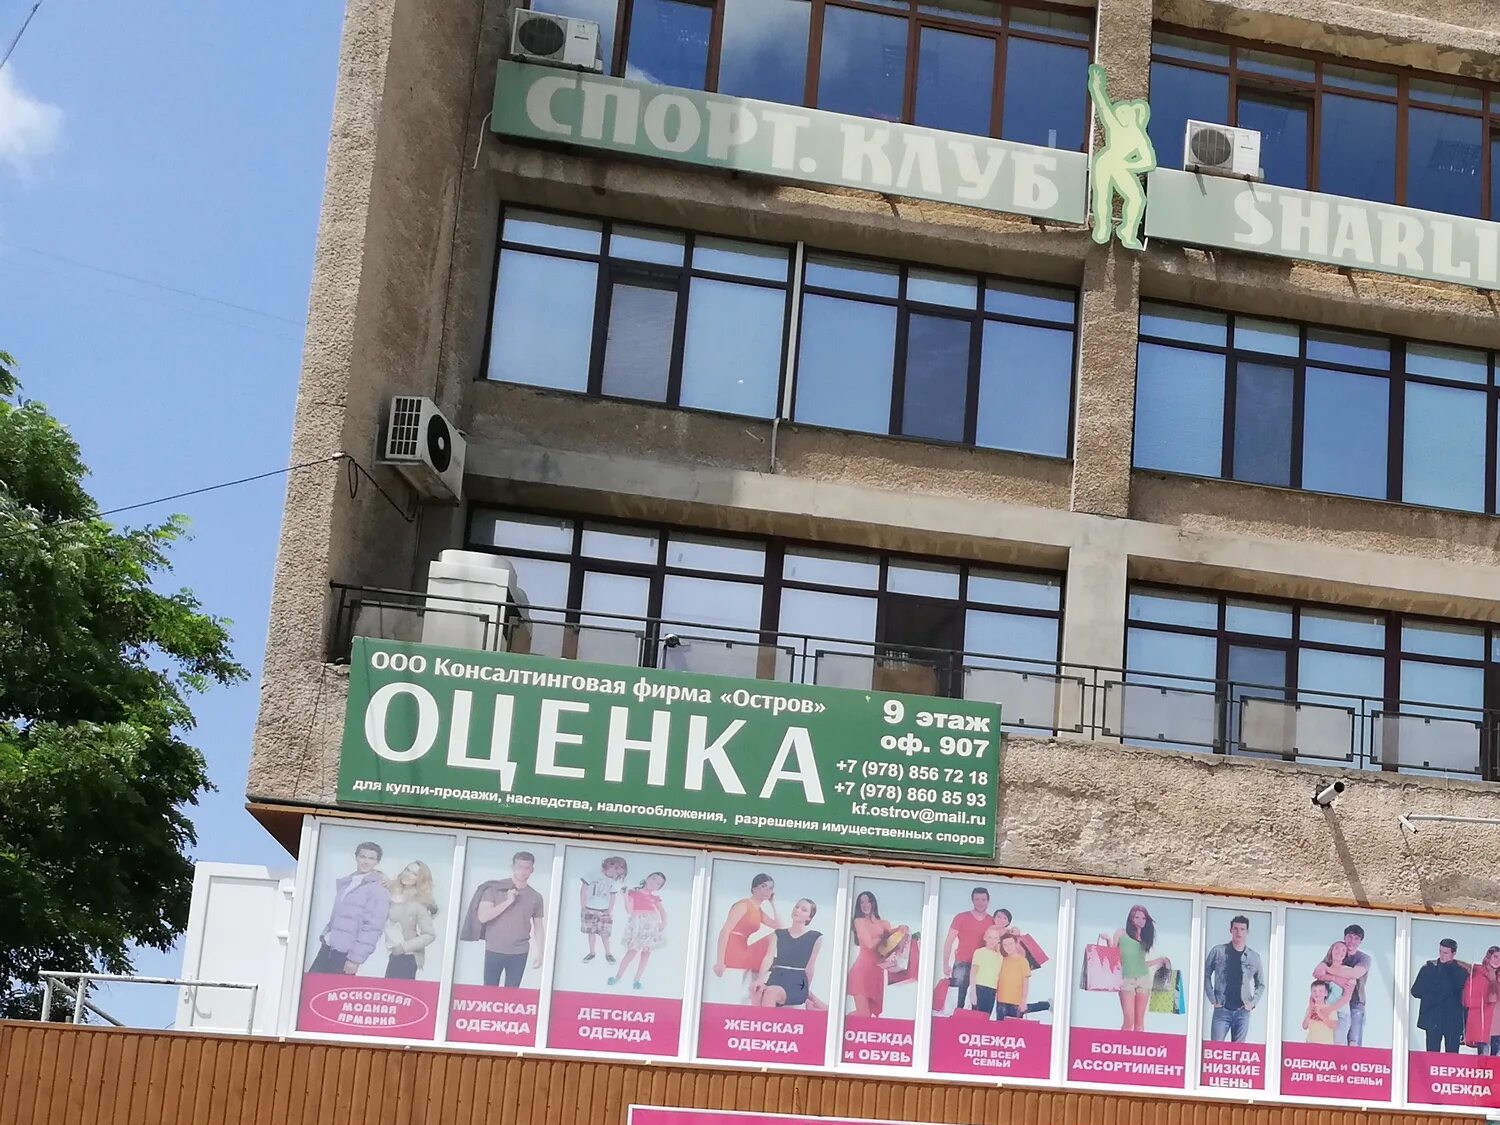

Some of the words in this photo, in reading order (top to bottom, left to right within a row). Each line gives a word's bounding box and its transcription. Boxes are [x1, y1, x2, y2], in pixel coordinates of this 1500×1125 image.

[525, 77, 819, 174] СПОРТ.
[840, 120, 1059, 211] КЛУБ
[371, 651, 426, 673] ООО
[434, 659, 626, 695] Консалтинговая
[633, 677, 711, 705] фирма
[720, 689, 826, 716] «Остров»
[884, 700, 904, 724] 9
[916, 710, 990, 732] этаж
[365, 682, 825, 803] ОЦЕНКА
[880, 734, 931, 756] оф.
[940, 737, 990, 758] 907
[836, 760, 857, 774] +7
[862, 761, 903, 781] (978)
[909, 766, 939, 780] 856
[943, 769, 964, 783] 72
[969, 771, 988, 784] 18
[834, 782, 855, 796] +7
[860, 784, 902, 803] (978)
[907, 788, 937, 803] 860
[942, 791, 961, 805] 85
[966, 793, 986, 807] 93
[353, 779, 381, 791] для
[386, 783, 502, 803] купли-продажи,
[506, 792, 593, 812] наследства,
[597, 801, 728, 823] налогообложения,
[735, 814, 819, 831] разрешения
[822, 821, 932, 841] имущественных
[936, 832, 985, 845] споров
[852, 802, 986, 825] kf.ostrov@mail.ru
[453, 999, 537, 1015] МУЖСКАЯ
[578, 1008, 655, 1023] ДЕТСКАЯ
[456, 1019, 530, 1034] ОДЕЖДА
[579, 1026, 651, 1042] ОДЕЖДА
[724, 1019, 804, 1035] ЖЕНСКАЯ
[728, 1037, 798, 1053] ОДЕЖДА
[845, 1030, 912, 1046] ОДЕЖДА
[958, 1033, 1026, 1049] ОДЕЖДА
[859, 1049, 911, 1063] ОБУВЬ
[964, 1049, 987, 1058] ДЛЯ
[991, 1049, 1019, 1060] ВСЕЙ
[1091, 1042, 1167, 1058] БОЛЬШОЙ
[1204, 1049, 1260, 1063] ВСЕГДА
[972, 1058, 1010, 1068] СЕМЬИ
[1072, 1059, 1183, 1076] АССОРТИМЕНТ
[1203, 1064, 1260, 1076] НИЗКИЕ
[1284, 1058, 1336, 1071] ОДЕЖДА
[1351, 1063, 1391, 1074] ОБУВЬ
[1291, 1072, 1313, 1082] ДЛЯ
[1316, 1074, 1344, 1084] ВСЕЙ
[1347, 1076, 1383, 1086] СЕМЬИ
[1430, 1066, 1493, 1080] ВЕРХНЯЯ
[1209, 1077, 1252, 1089] ЦЕНЫ
[1432, 1083, 1491, 1097] ОДЕЖДА
